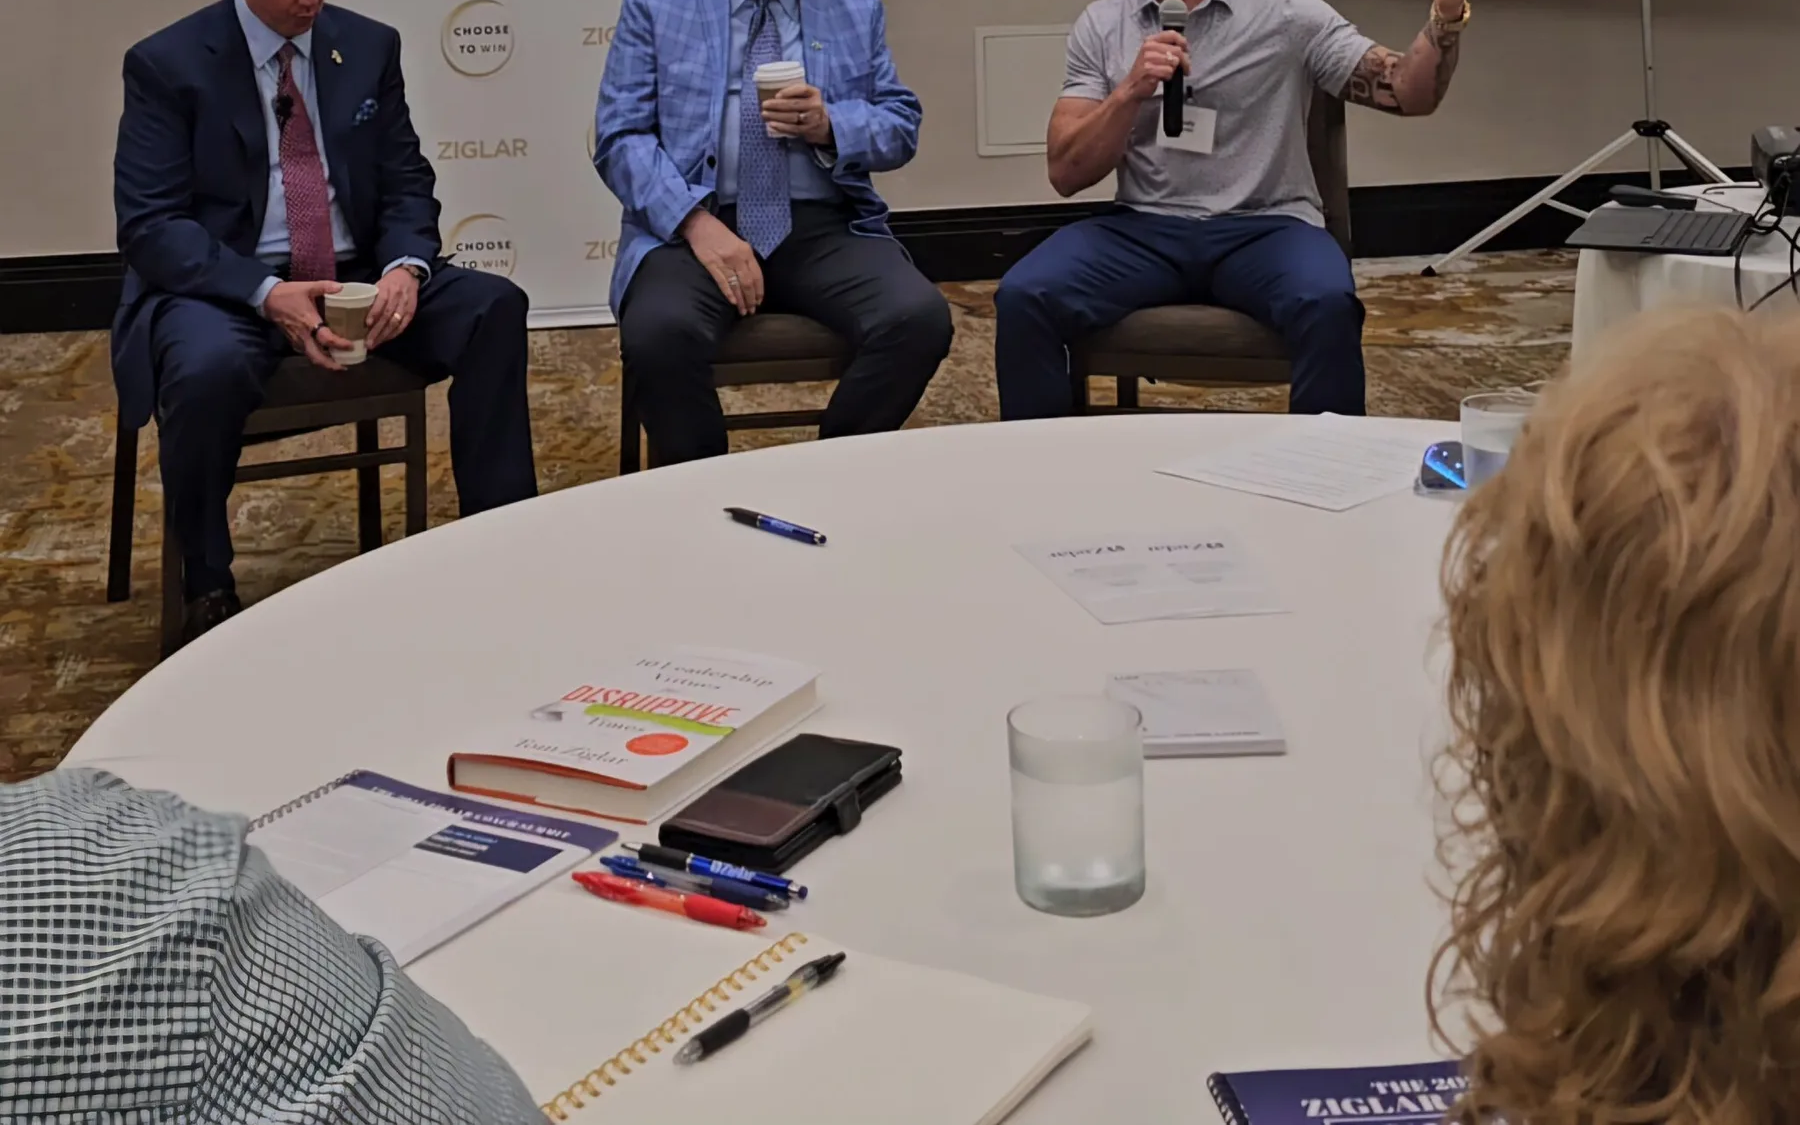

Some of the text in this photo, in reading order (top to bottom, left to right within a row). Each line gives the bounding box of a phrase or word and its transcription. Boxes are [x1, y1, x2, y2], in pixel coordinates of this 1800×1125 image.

[453, 25, 509, 36] CHOOSE
[459, 44, 506, 54] TO WIN
[437, 138, 528, 161] ZIGLAR
[456, 241, 511, 252] CHOOSE
[461, 260, 508, 269] TO WIN
[561, 684, 741, 725] DISRUPTIVE
[560, 746, 629, 765] Ziglar
[1370, 1078, 1429, 1095] THE
[1301, 1093, 1449, 1117] ZIGLAR
